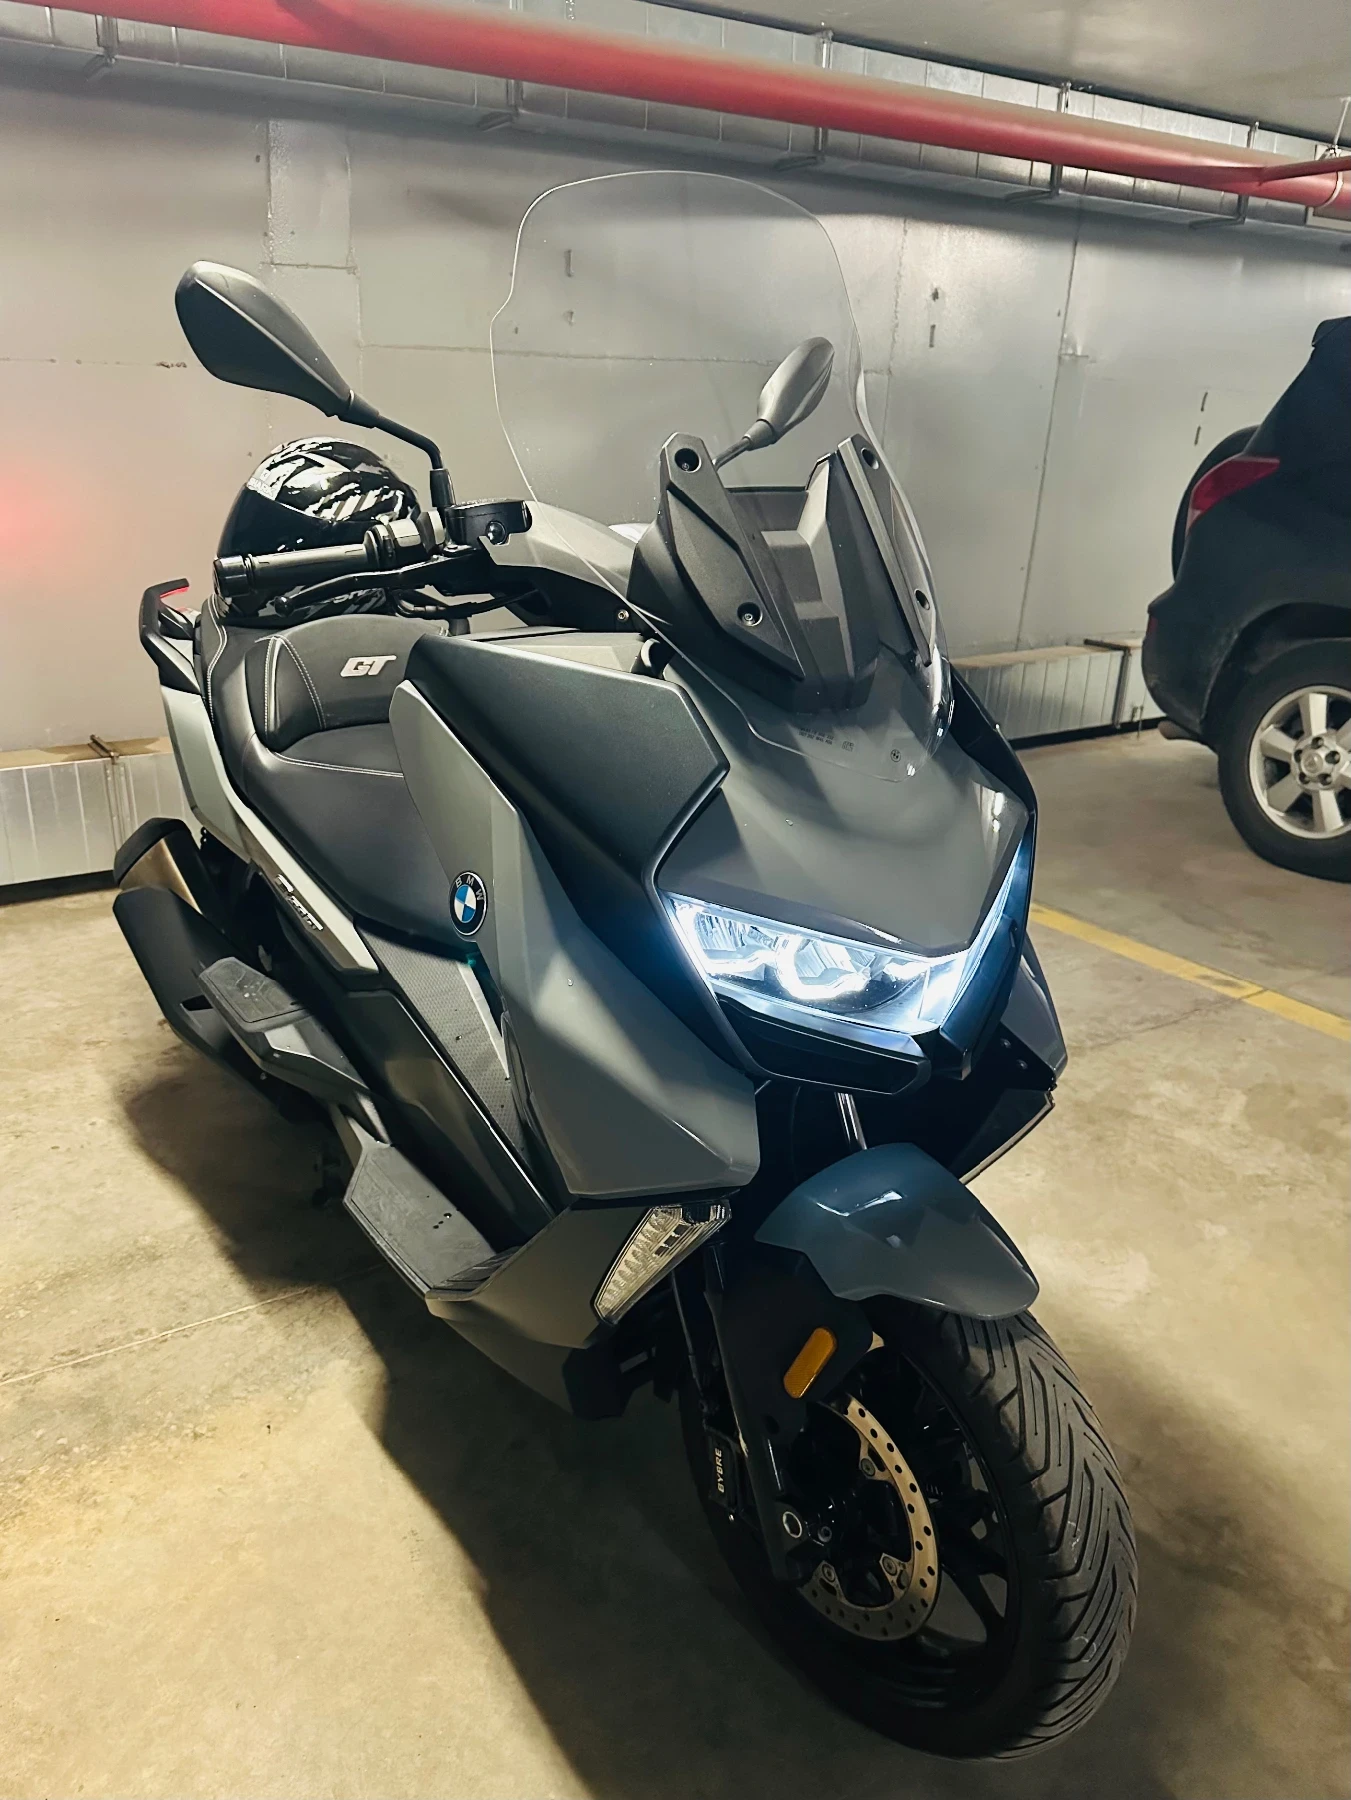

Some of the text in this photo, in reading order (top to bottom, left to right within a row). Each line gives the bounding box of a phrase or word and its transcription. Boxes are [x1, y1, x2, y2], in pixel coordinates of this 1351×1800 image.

[340, 655, 397, 677] GT
[455, 875, 484, 901] BMW
[715, 1447, 725, 1493] BYBRE
